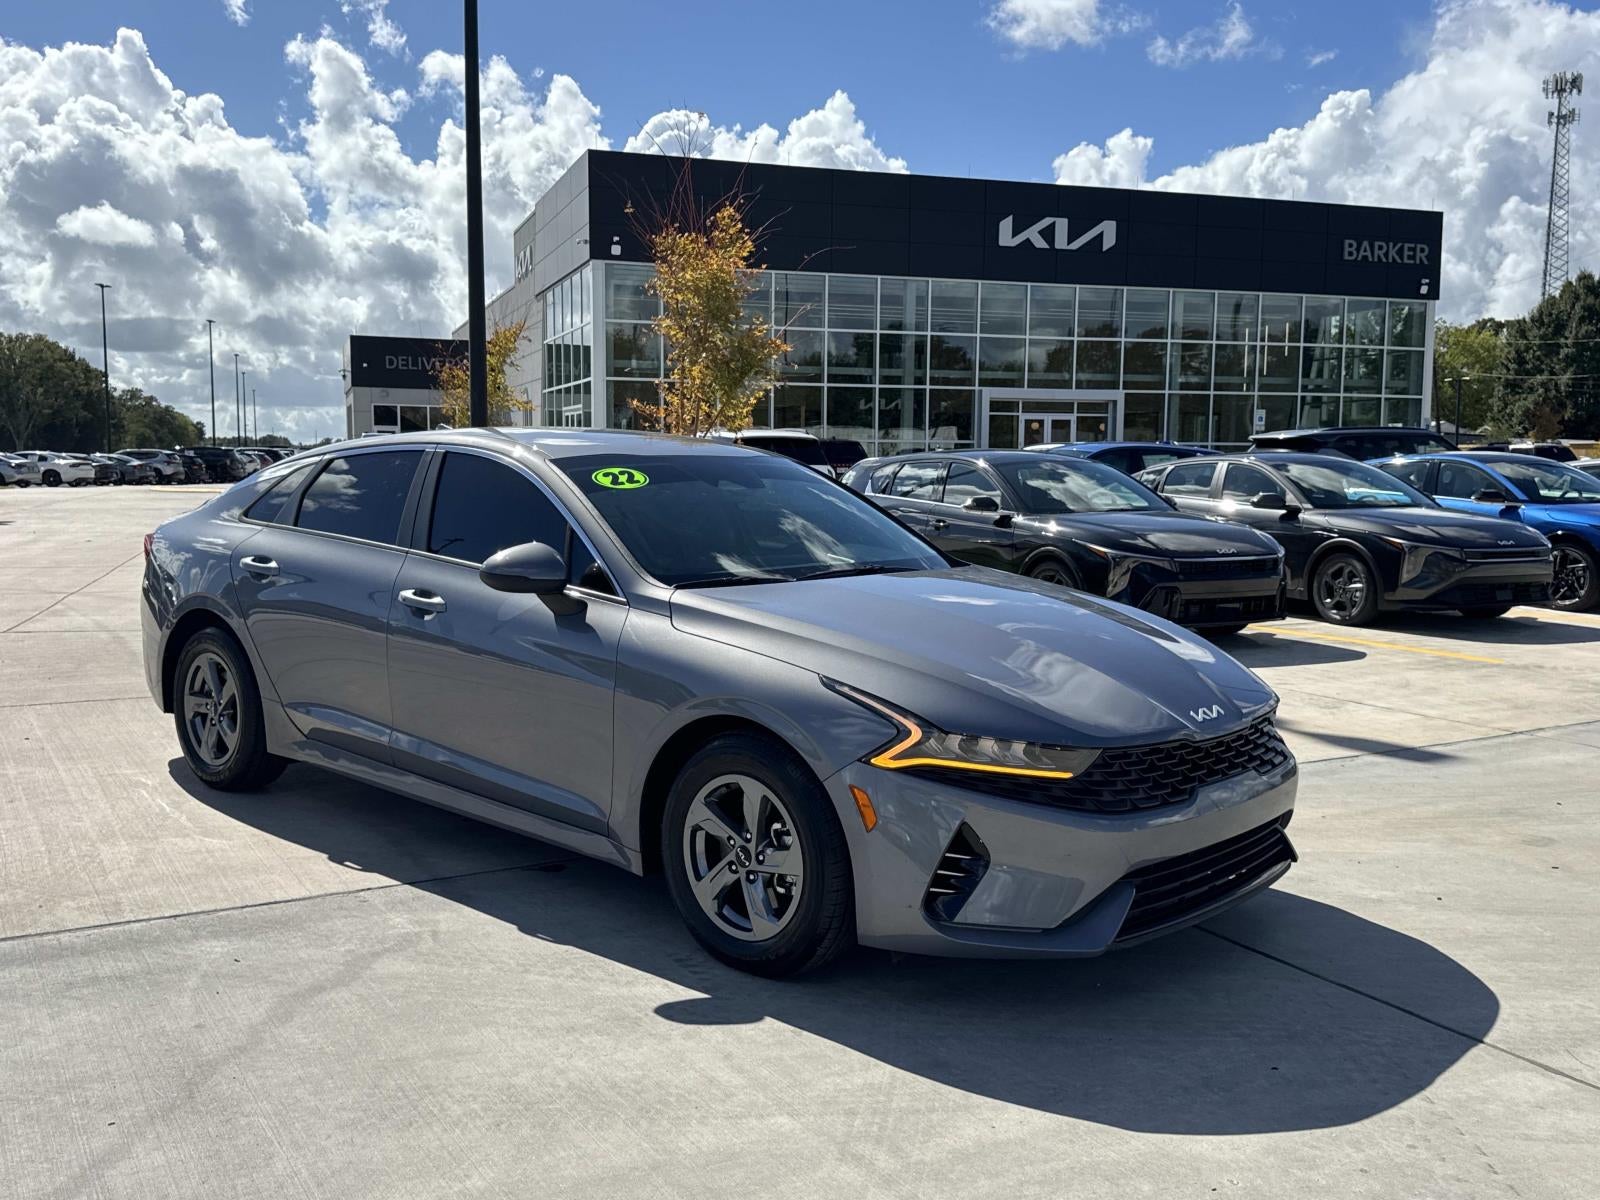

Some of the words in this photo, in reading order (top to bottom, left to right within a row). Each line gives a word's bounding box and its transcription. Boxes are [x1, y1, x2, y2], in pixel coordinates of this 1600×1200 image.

[998, 214, 1117, 252] KIA
[1343, 240, 1430, 265] BARKER
[602, 470, 641, 485] 22
[1190, 704, 1225, 722] KIA
